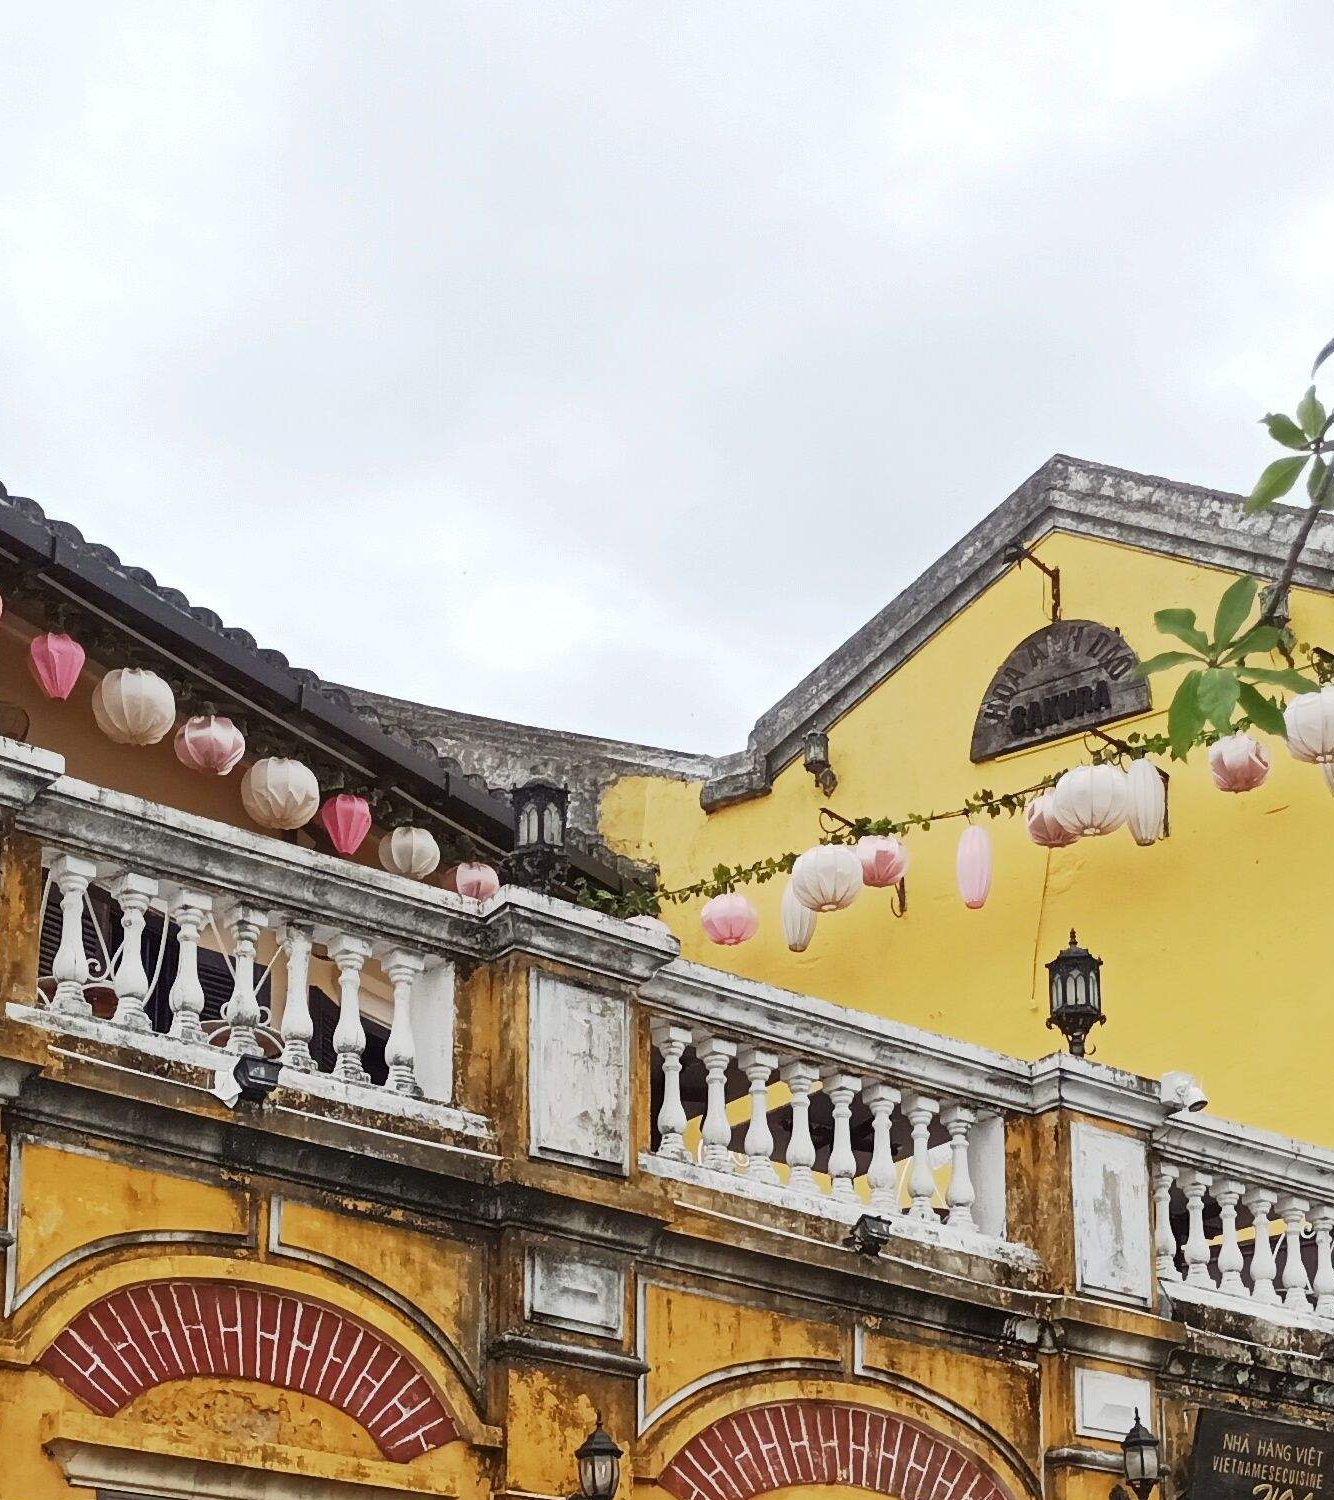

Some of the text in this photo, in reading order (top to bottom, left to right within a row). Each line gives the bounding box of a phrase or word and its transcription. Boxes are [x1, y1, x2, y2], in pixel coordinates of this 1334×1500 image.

[1010, 679, 1112, 737] SAKURA
[1223, 1433, 1250, 1454] NHÀ
[1257, 1438, 1292, 1462] HÀNG
[1296, 1446, 1324, 1468] VIỆT
